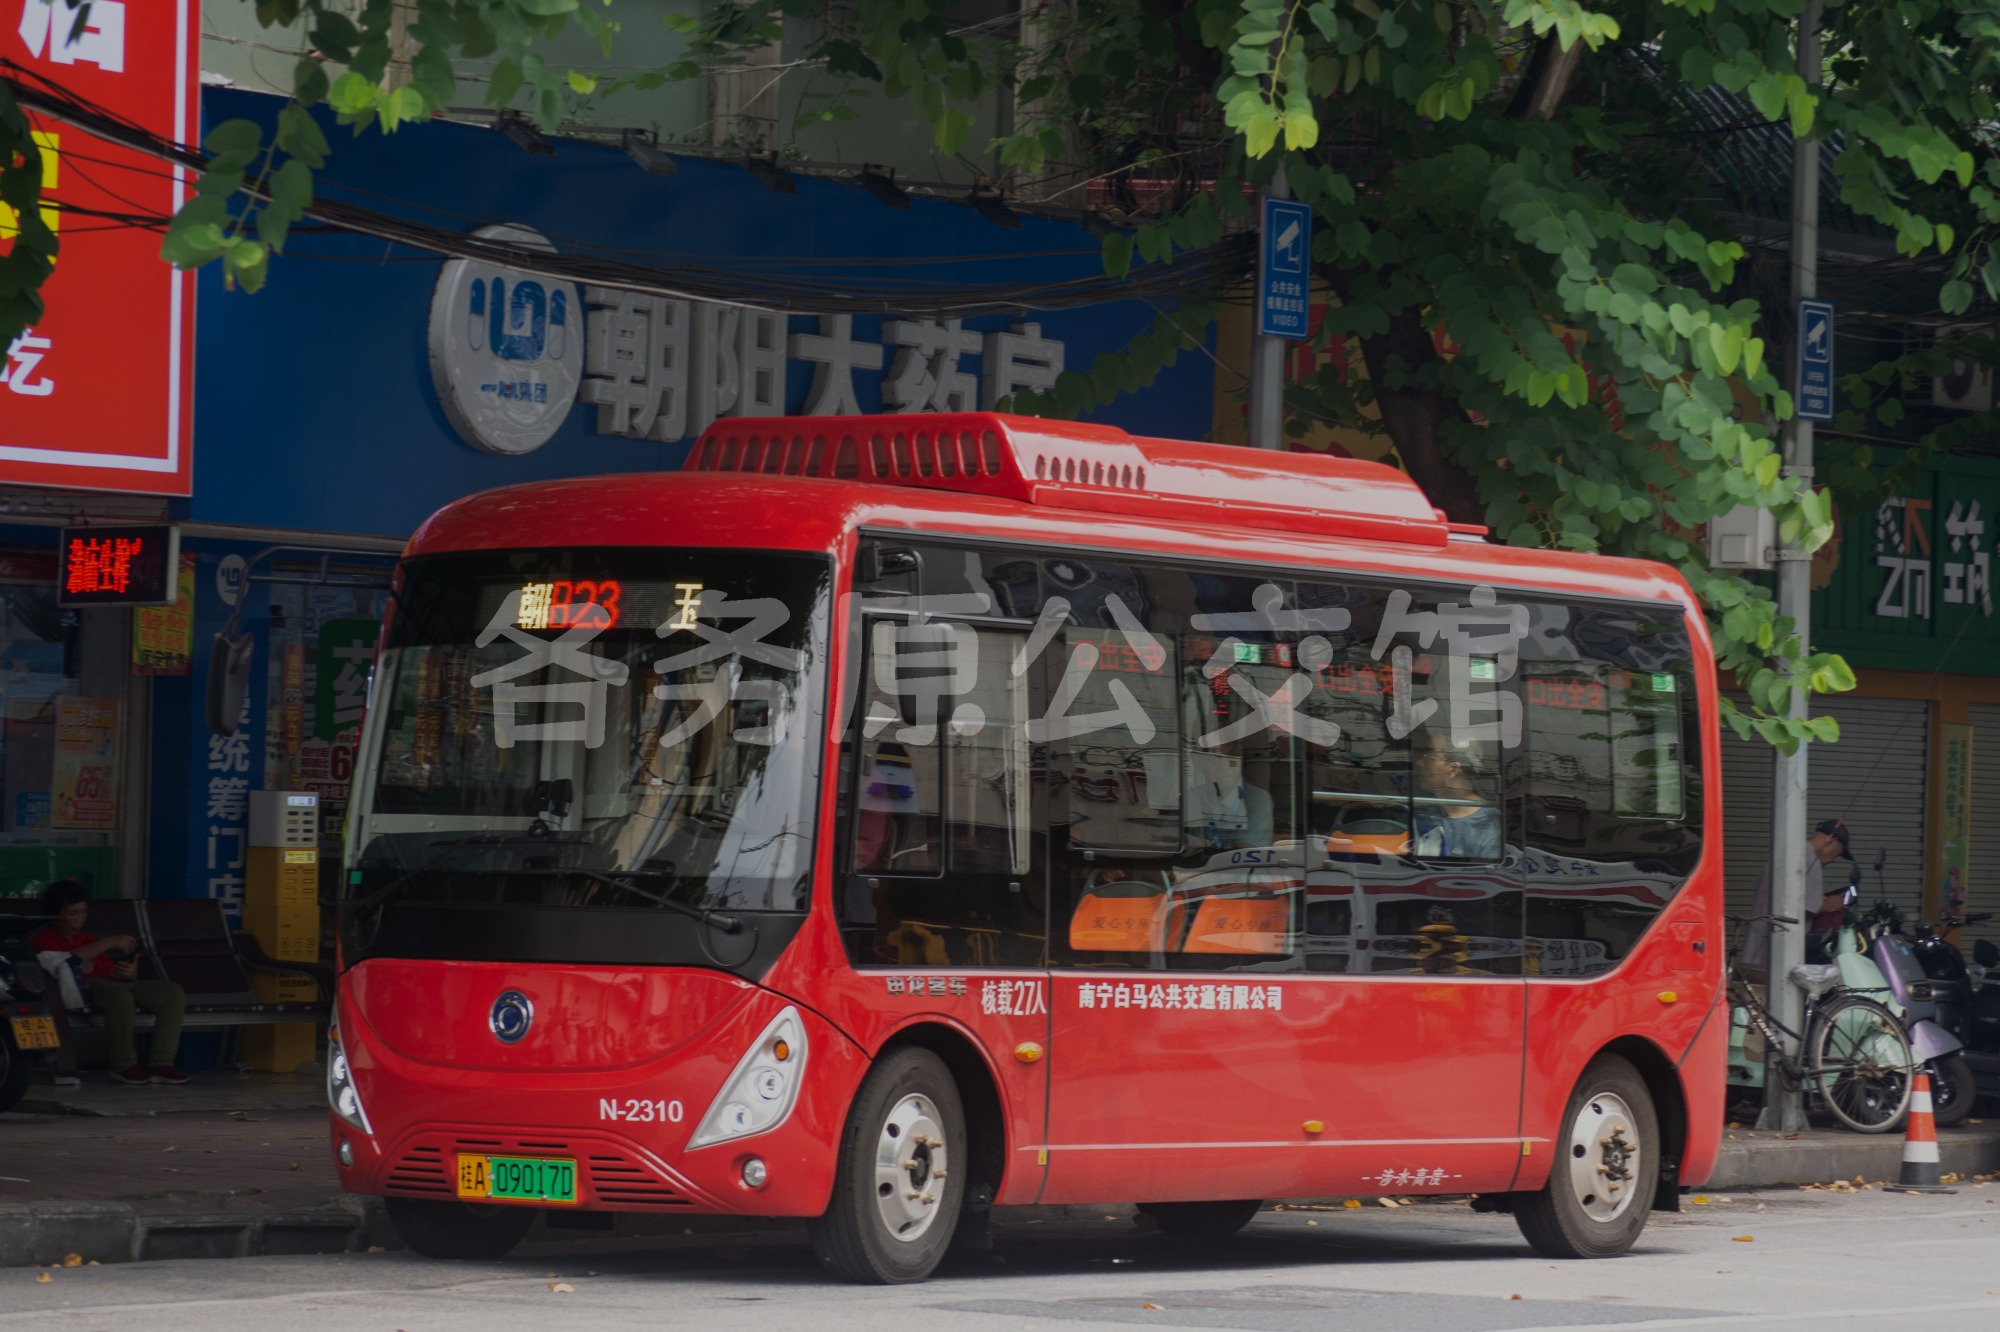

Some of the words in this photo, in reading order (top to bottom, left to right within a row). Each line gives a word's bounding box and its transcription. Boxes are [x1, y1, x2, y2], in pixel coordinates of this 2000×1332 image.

[1271, 281, 1301, 296] 公共安全
[1272, 314, 1298, 327] VIDEO
[331, 746, 352, 781] 6
[980, 979, 1047, 1016] 核载27人
[1078, 983, 1284, 1012] 南宁白马公共交通有限公司
[598, 1098, 686, 1123] N-2310
